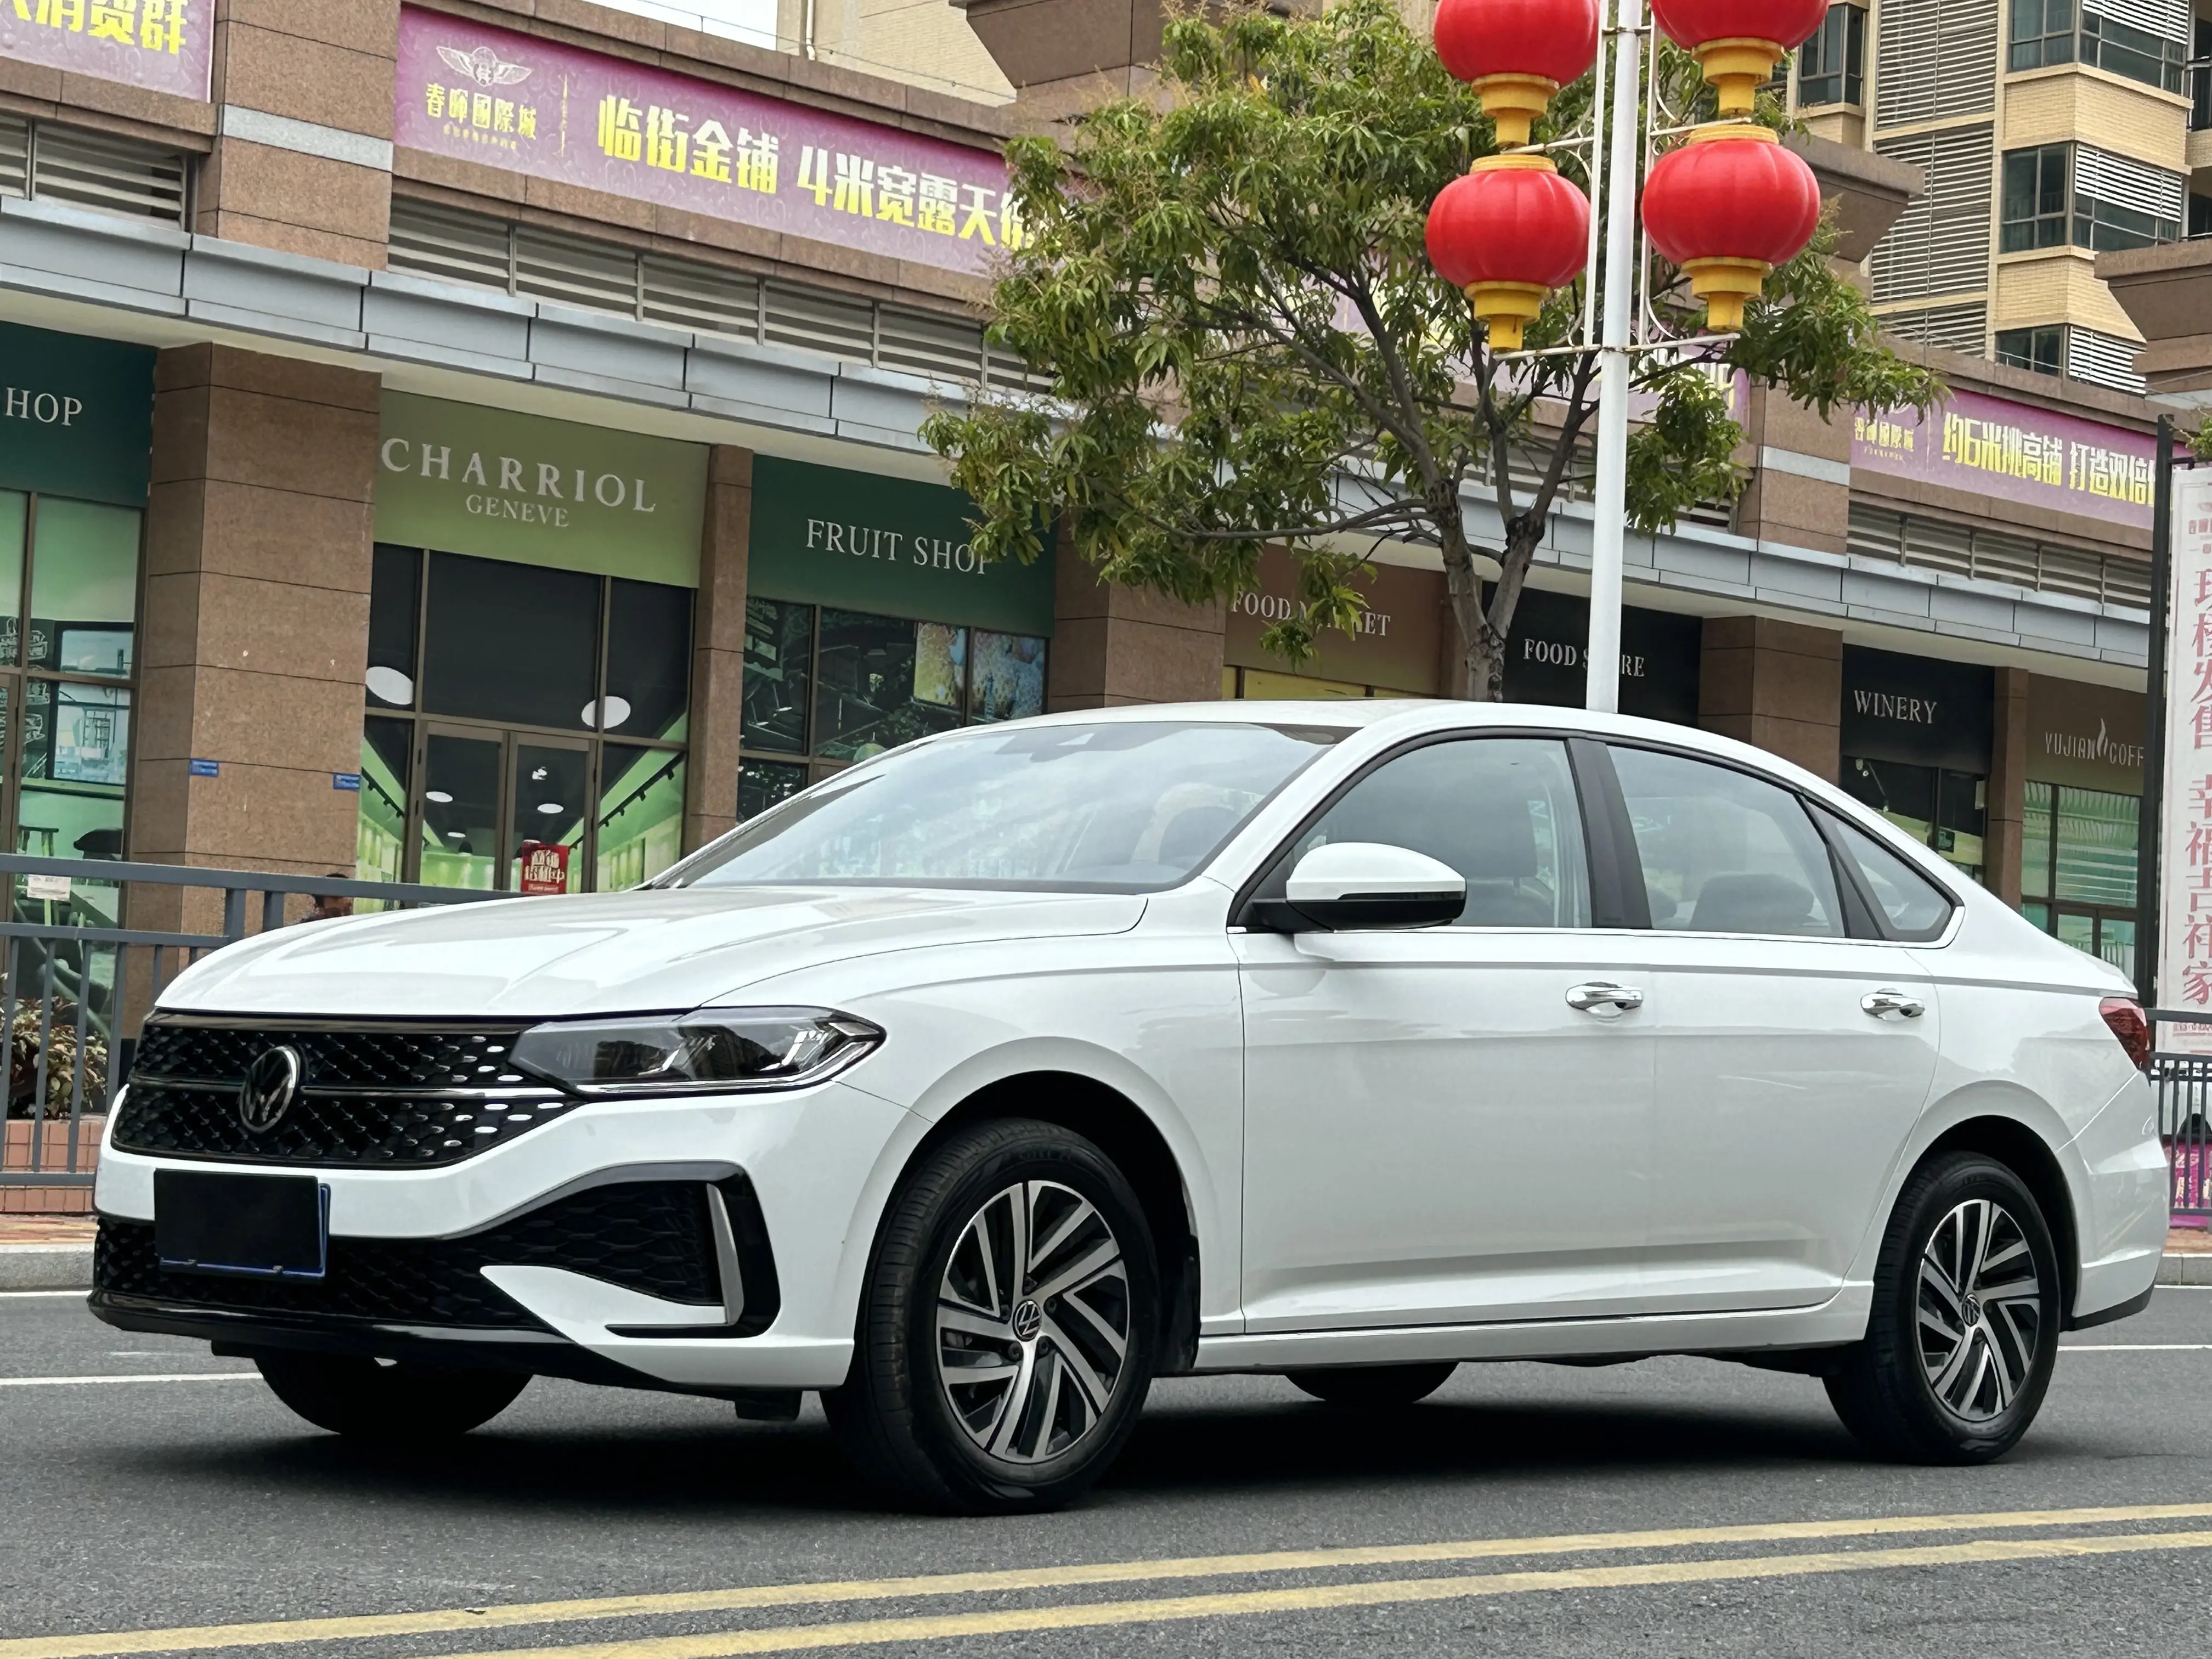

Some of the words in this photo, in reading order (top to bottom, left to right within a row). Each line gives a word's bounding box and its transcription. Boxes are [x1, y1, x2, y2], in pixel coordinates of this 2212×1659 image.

[597, 94, 778, 194] 临街金铺
[381, 437, 657, 512] CHARRIOL
[465, 494, 569, 527] GENEVE
[805, 518, 903, 561] FRUIT
[1231, 590, 1292, 620] FOOD
[1523, 639, 1577, 665] FOOD
[1854, 690, 1937, 724] WINERY
